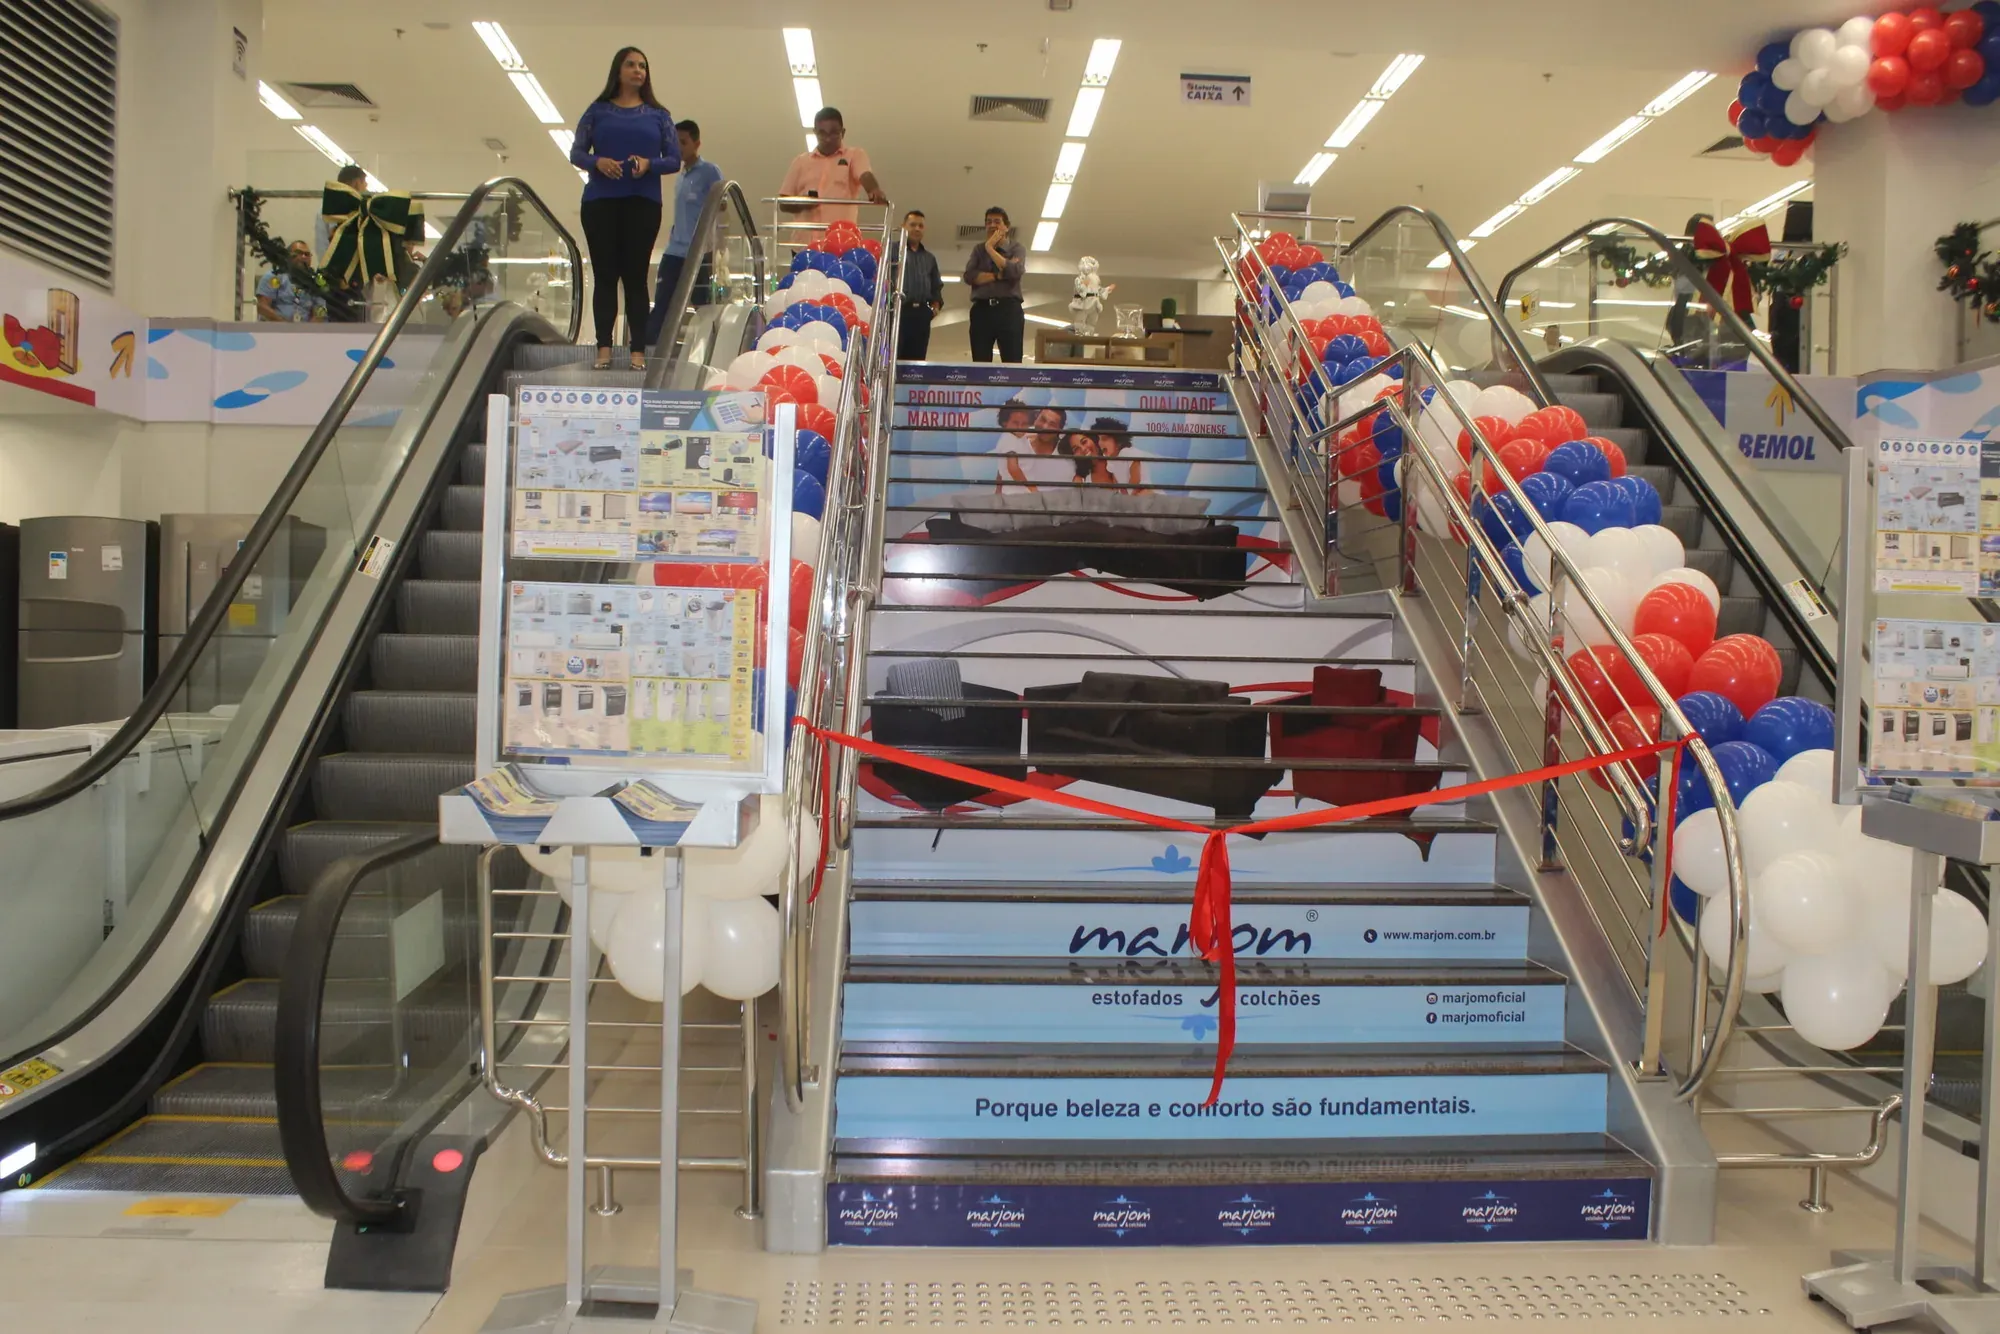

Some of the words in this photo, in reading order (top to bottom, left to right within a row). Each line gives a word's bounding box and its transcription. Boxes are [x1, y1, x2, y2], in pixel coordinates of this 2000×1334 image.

[1187, 91, 1223, 101] CAIXA
[908, 389, 982, 405] PRODUTOS
[1139, 395, 1217, 411] QUALIDADE
[907, 410, 970, 428] MARJOM
[1146, 422, 1170, 432] 100%
[1171, 422, 1227, 435] AMAZONENSE
[1738, 433, 1816, 461] BEMOL
[1383, 930, 1496, 943] www.marjom.com.br
[1091, 990, 1183, 1006] estofados
[1240, 990, 1321, 1006] colchões
[1442, 992, 1526, 1006] marjomoficial
[1441, 1011, 1525, 1026] marjomoficial
[975, 1098, 1059, 1122] Porque
[1066, 1098, 1141, 1118] beleza
[1148, 1103, 1161, 1118] e
[1169, 1099, 1265, 1118] conforto
[1272, 1097, 1312, 1117] são
[1319, 1095, 1477, 1117] fundamentais.
[839, 1203, 898, 1226] marjom
[967, 1204, 1025, 1228] marjom
[1093, 1204, 1151, 1227] marjom
[1218, 1203, 1275, 1226] marjom
[1341, 1201, 1398, 1225] marjom
[1462, 1200, 1517, 1222] marjom
[1581, 1198, 1635, 1221] marjom
